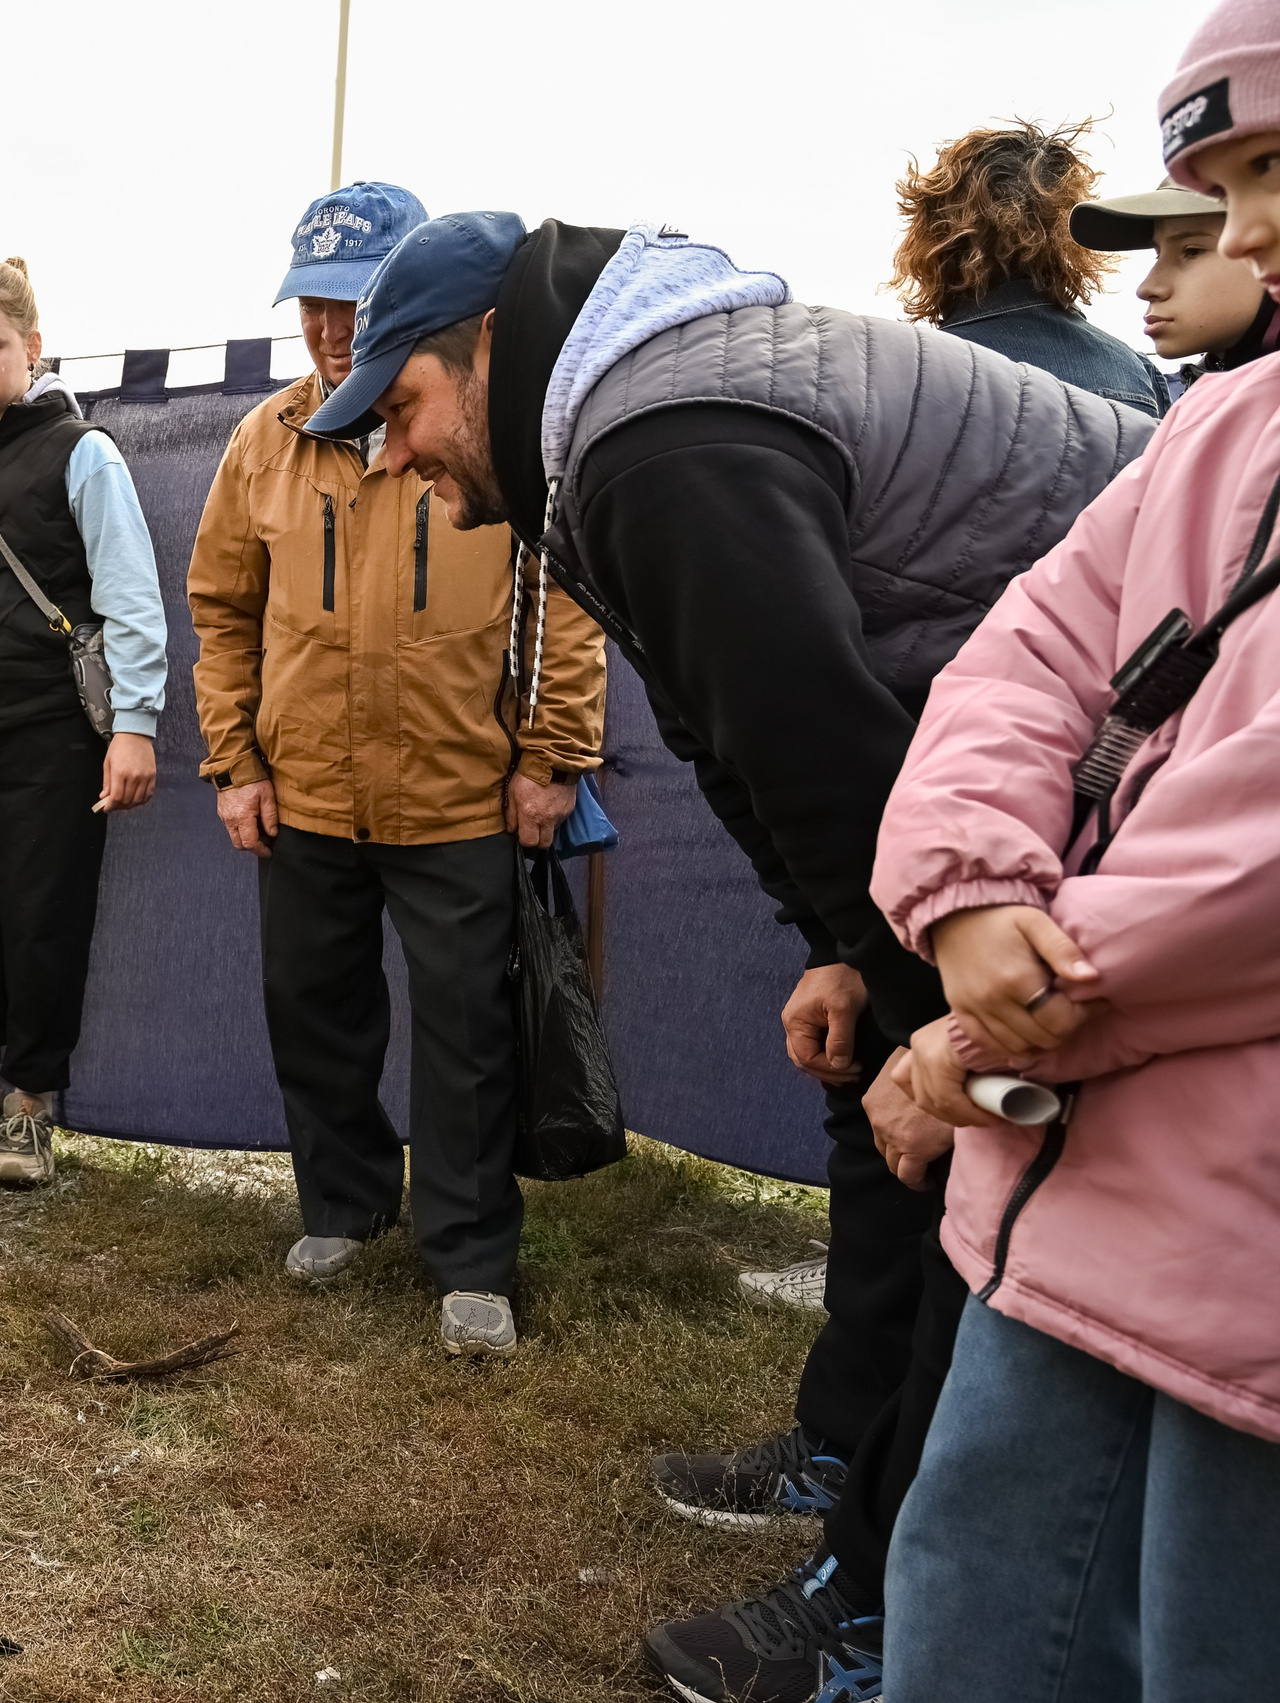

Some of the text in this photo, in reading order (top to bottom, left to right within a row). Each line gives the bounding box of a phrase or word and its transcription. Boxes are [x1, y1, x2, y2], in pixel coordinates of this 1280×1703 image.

[318, 205, 350, 214] ORONTO
[332, 211, 372, 233] LEAFS
[344, 239, 363, 247] 1917
